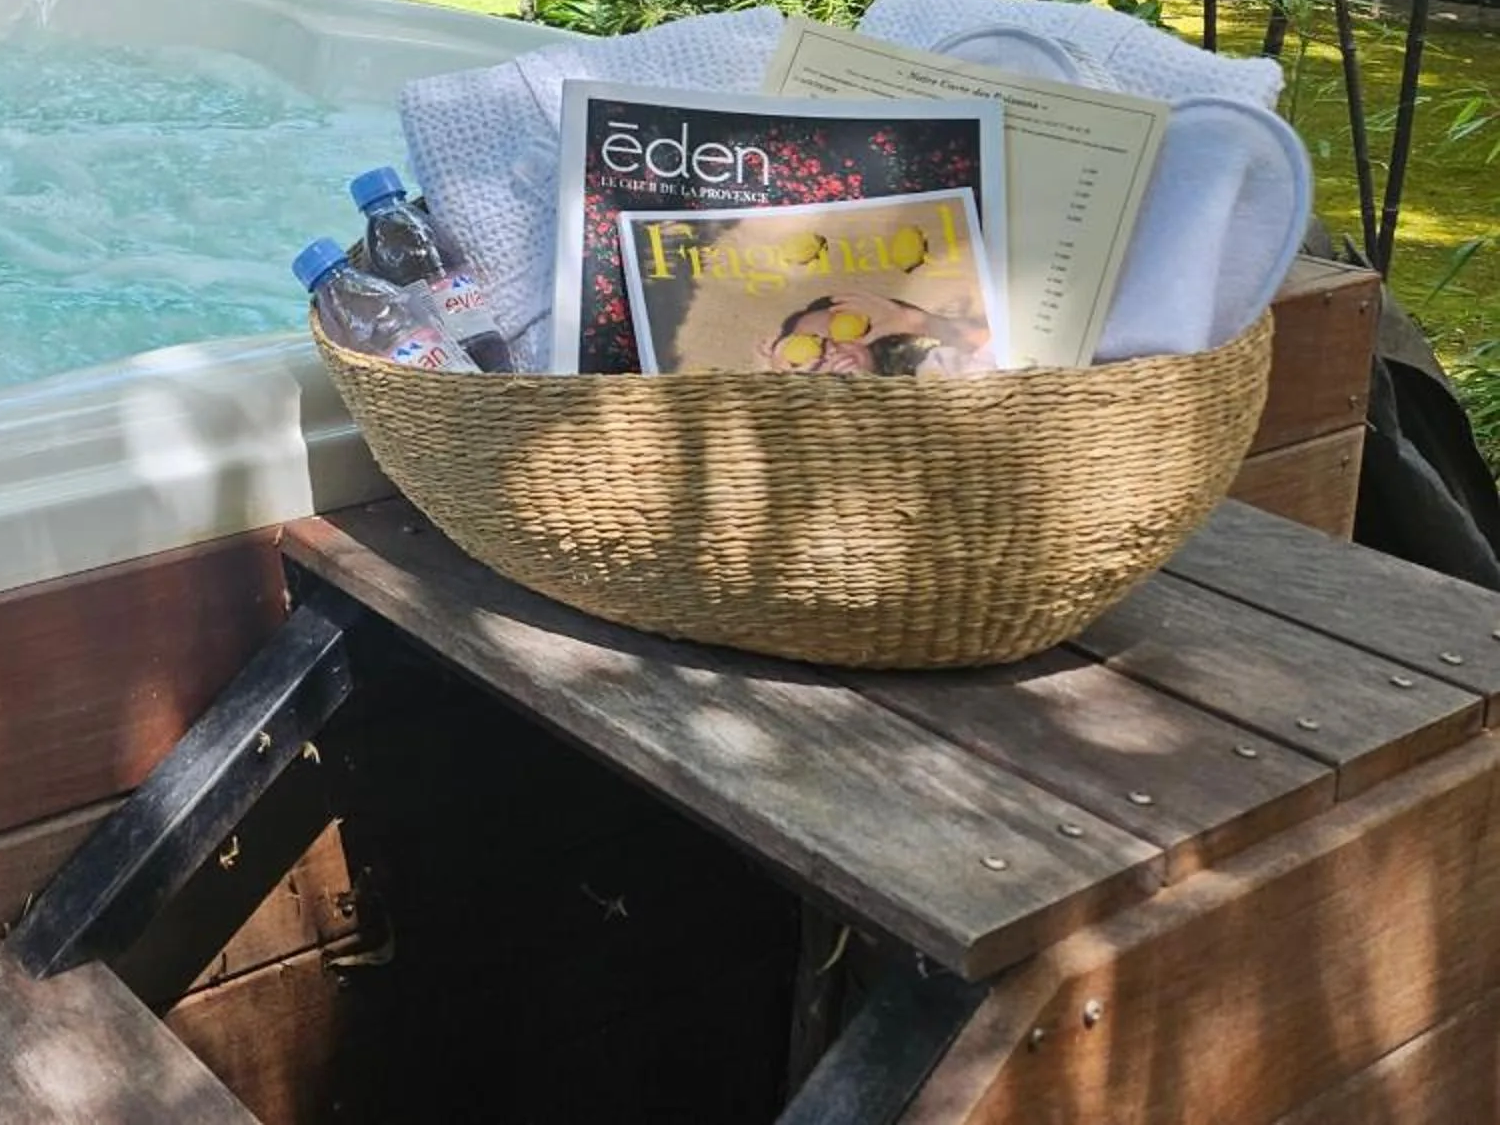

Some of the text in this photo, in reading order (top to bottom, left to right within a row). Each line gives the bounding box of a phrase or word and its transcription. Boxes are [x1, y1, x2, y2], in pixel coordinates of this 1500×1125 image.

[660, 182, 677, 195] DE
[681, 184, 698, 197] LA
[699, 186, 770, 204] PROVENCE
